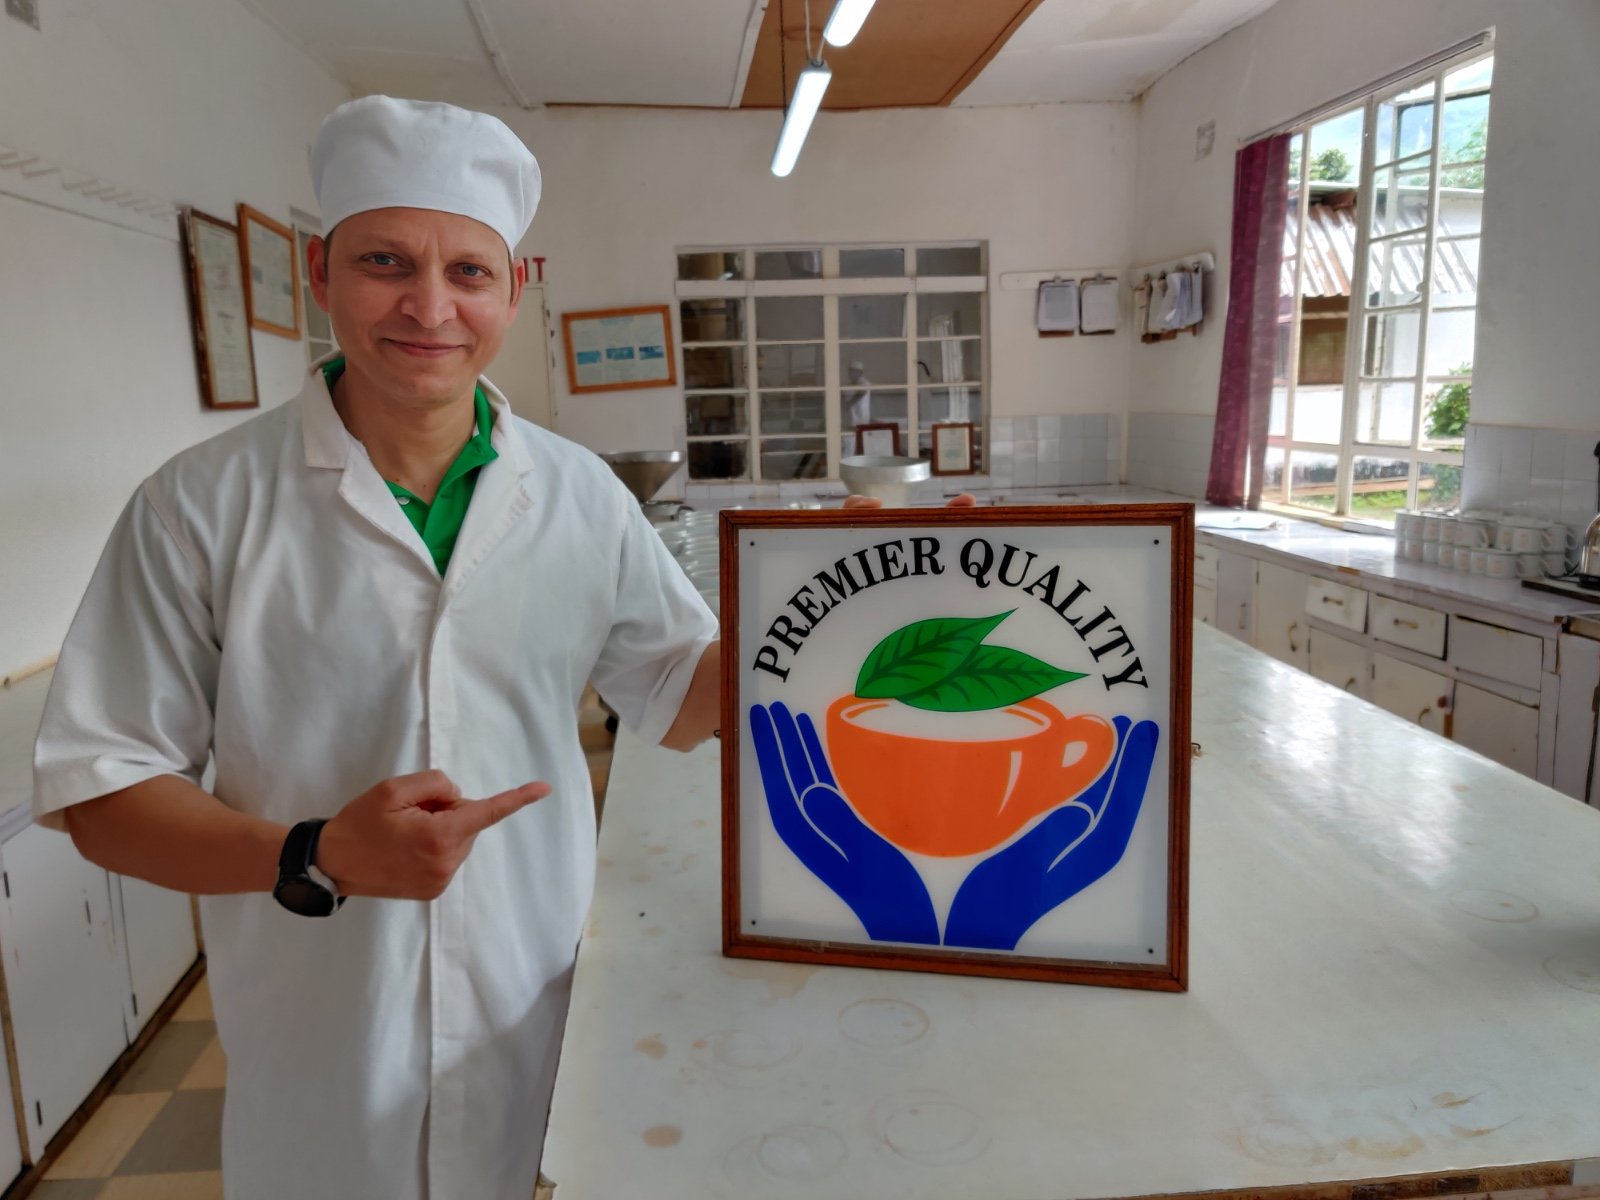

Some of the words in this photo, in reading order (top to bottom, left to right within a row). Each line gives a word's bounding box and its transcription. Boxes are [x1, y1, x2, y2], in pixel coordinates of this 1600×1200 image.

[523, 256, 546, 283] IT
[752, 536, 946, 683] PREMIER
[959, 537, 1149, 692] QUALITY
